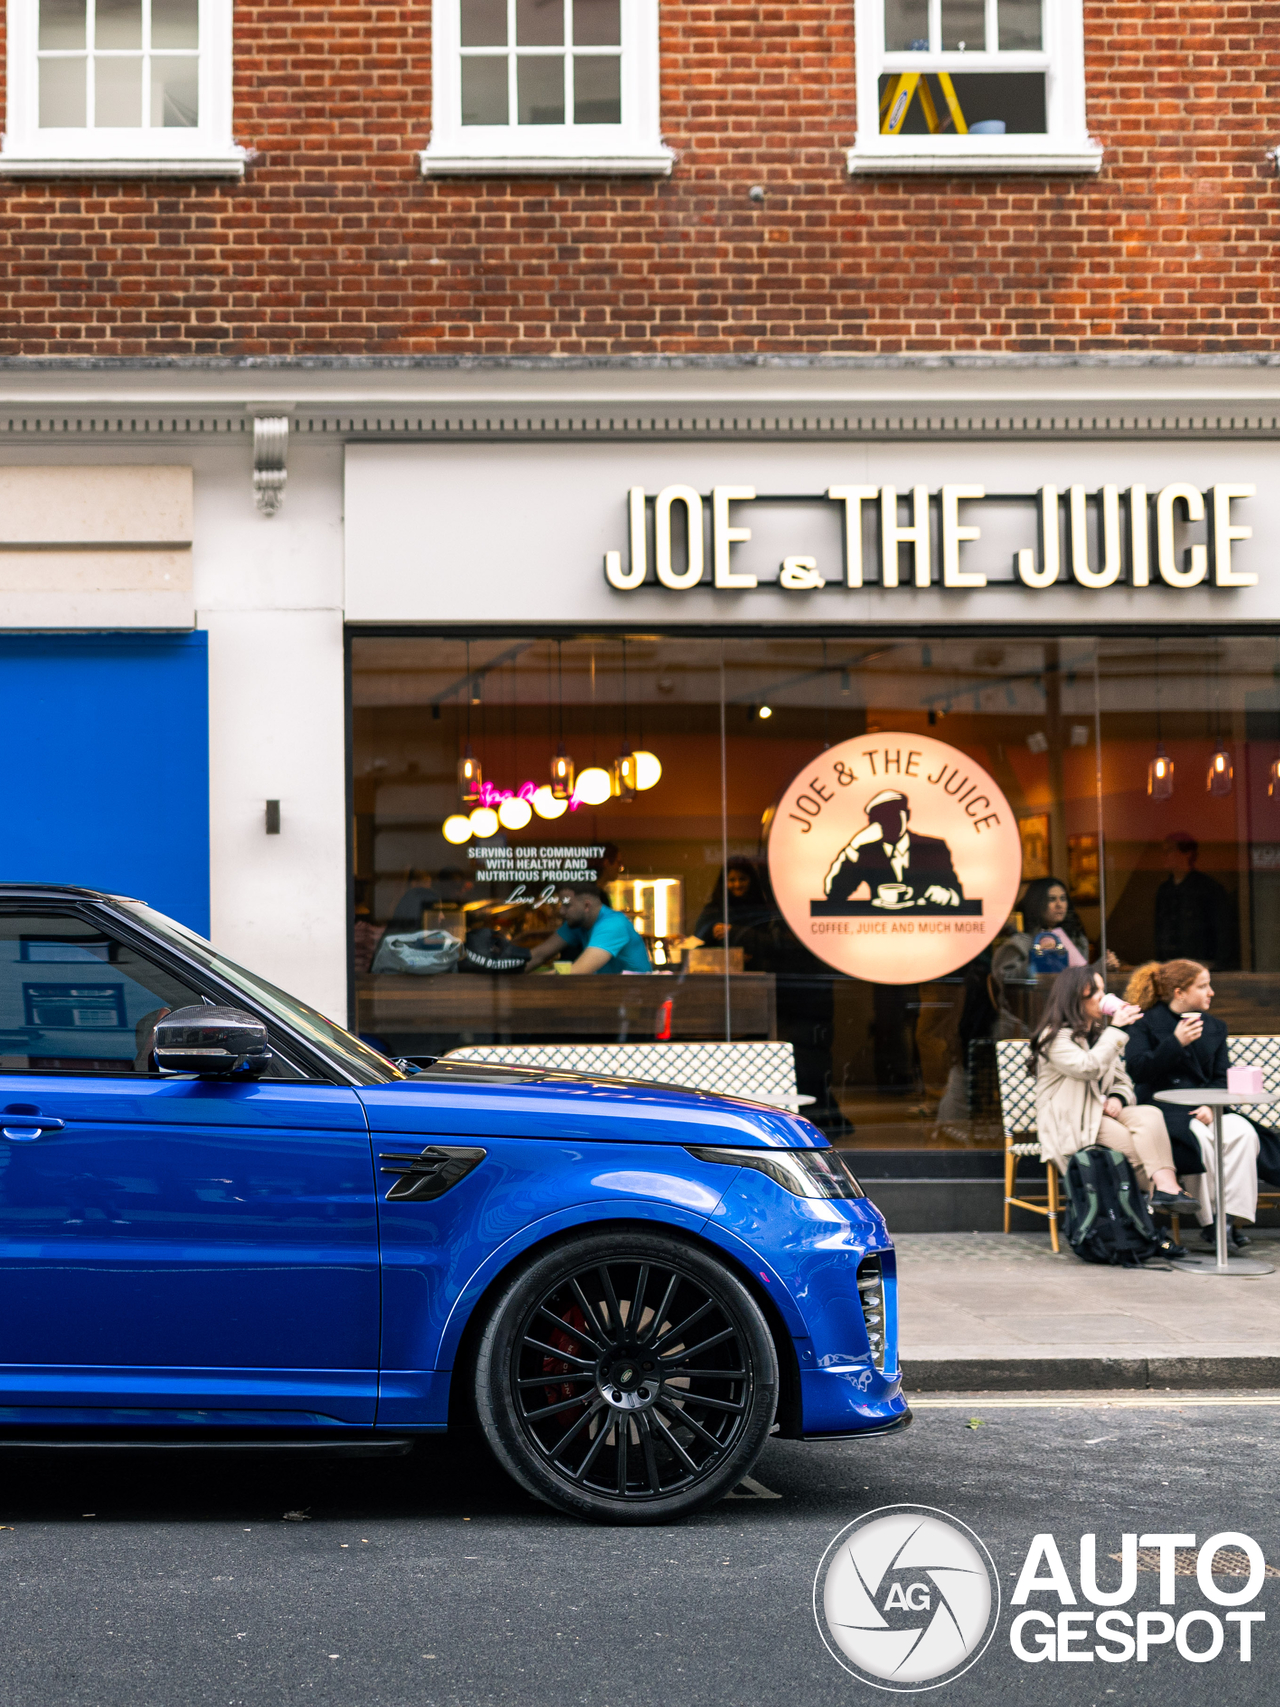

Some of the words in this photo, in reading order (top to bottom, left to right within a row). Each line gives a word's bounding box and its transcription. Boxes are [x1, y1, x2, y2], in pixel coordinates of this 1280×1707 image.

[606, 485, 758, 590] JOE
[780, 555, 825, 590] &
[828, 485, 987, 588] THE
[1015, 483, 1259, 588] JUICE
[789, 777, 835, 834] JOE
[833, 761, 858, 786] &
[862, 748, 922, 777] THE
[927, 764, 1001, 834] JUICE
[468, 847, 513, 859] SERVING
[516, 847, 537, 858] OUR
[540, 847, 606, 858] COMMUNITY
[486, 859, 514, 869] WITH
[516, 859, 562, 869] HEALTHY
[564, 859, 588, 869] AND
[477, 870, 539, 881] NUTRITIOUS
[542, 870, 597, 881] PRODUCTS
[505, 884, 535, 904] Love
[532, 884, 559, 909] Joe
[811, 922, 853, 935] COFFEE,
[856, 921, 888, 934] JUICE
[891, 921, 915, 934] AND
[918, 921, 951, 934] MUCH
[954, 921, 986, 934] MORE
